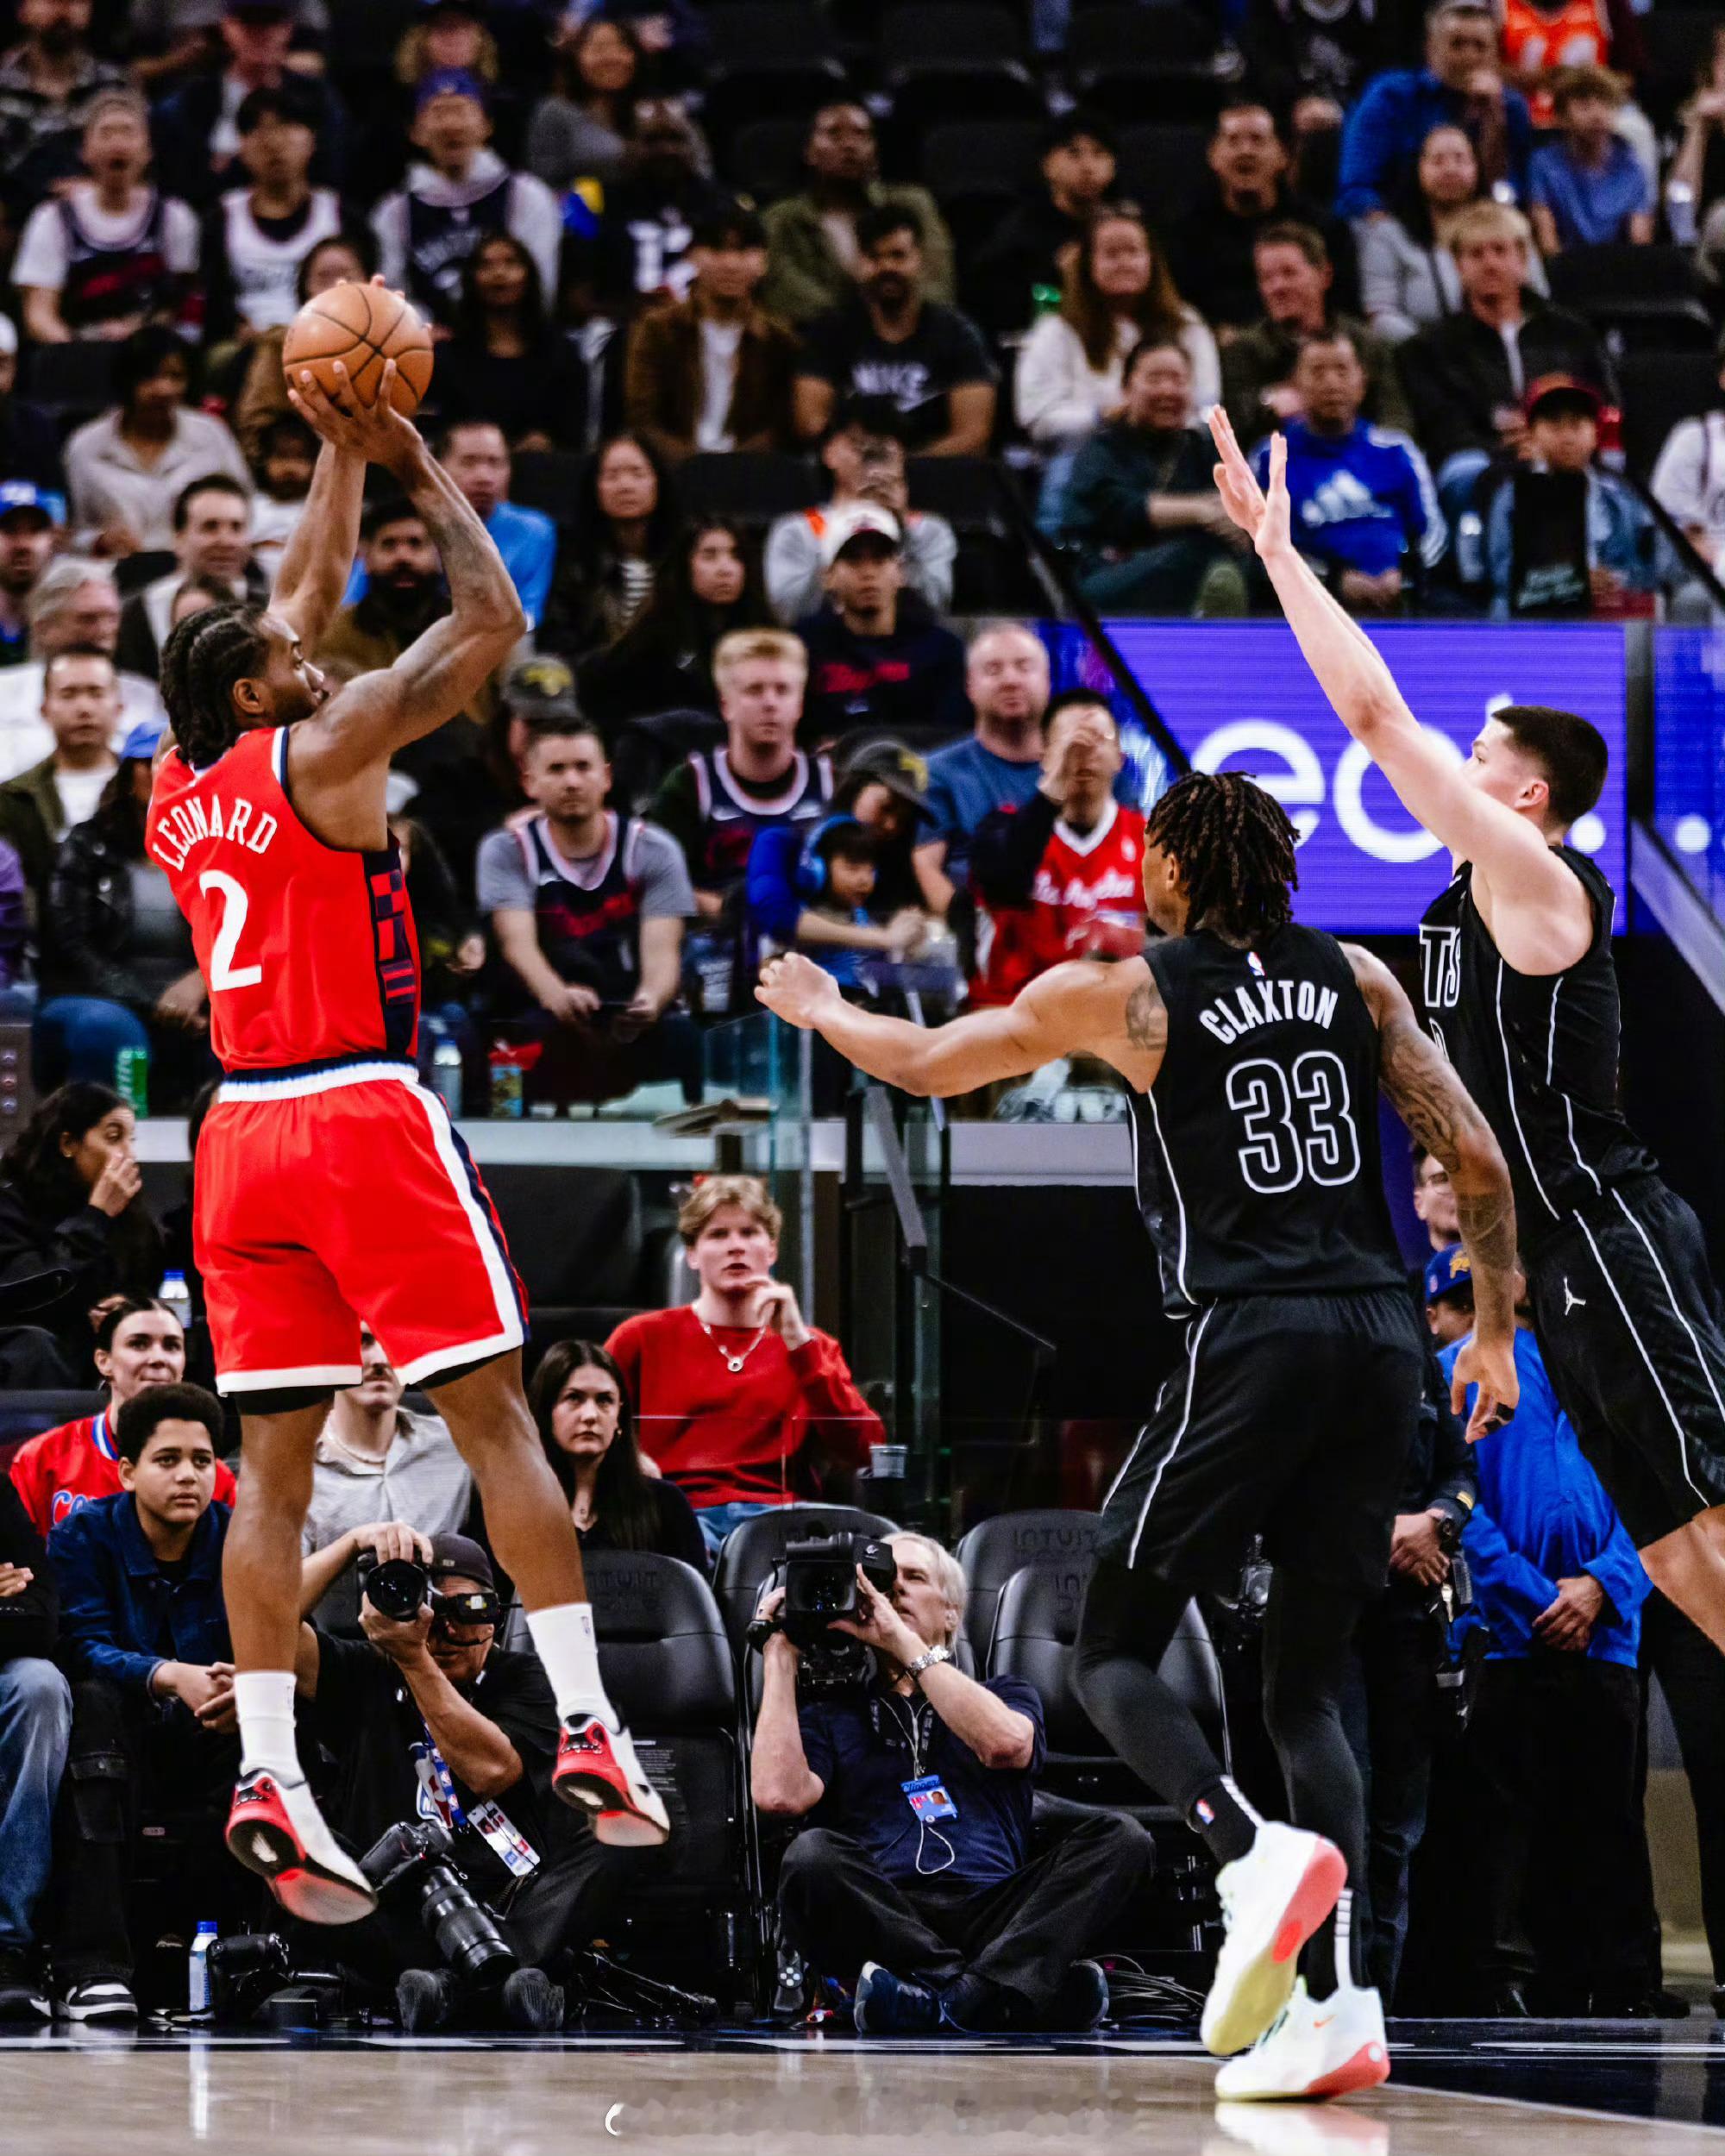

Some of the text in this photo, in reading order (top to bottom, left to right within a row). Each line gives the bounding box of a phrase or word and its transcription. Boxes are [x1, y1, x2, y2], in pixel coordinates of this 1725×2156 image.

[152, 793, 278, 872] LEONARD
[198, 868, 262, 992] 2
[1419, 924, 1460, 1007] TS
[1199, 980, 1339, 1044] CLAXTON
[1225, 1050, 1361, 1194] 33
